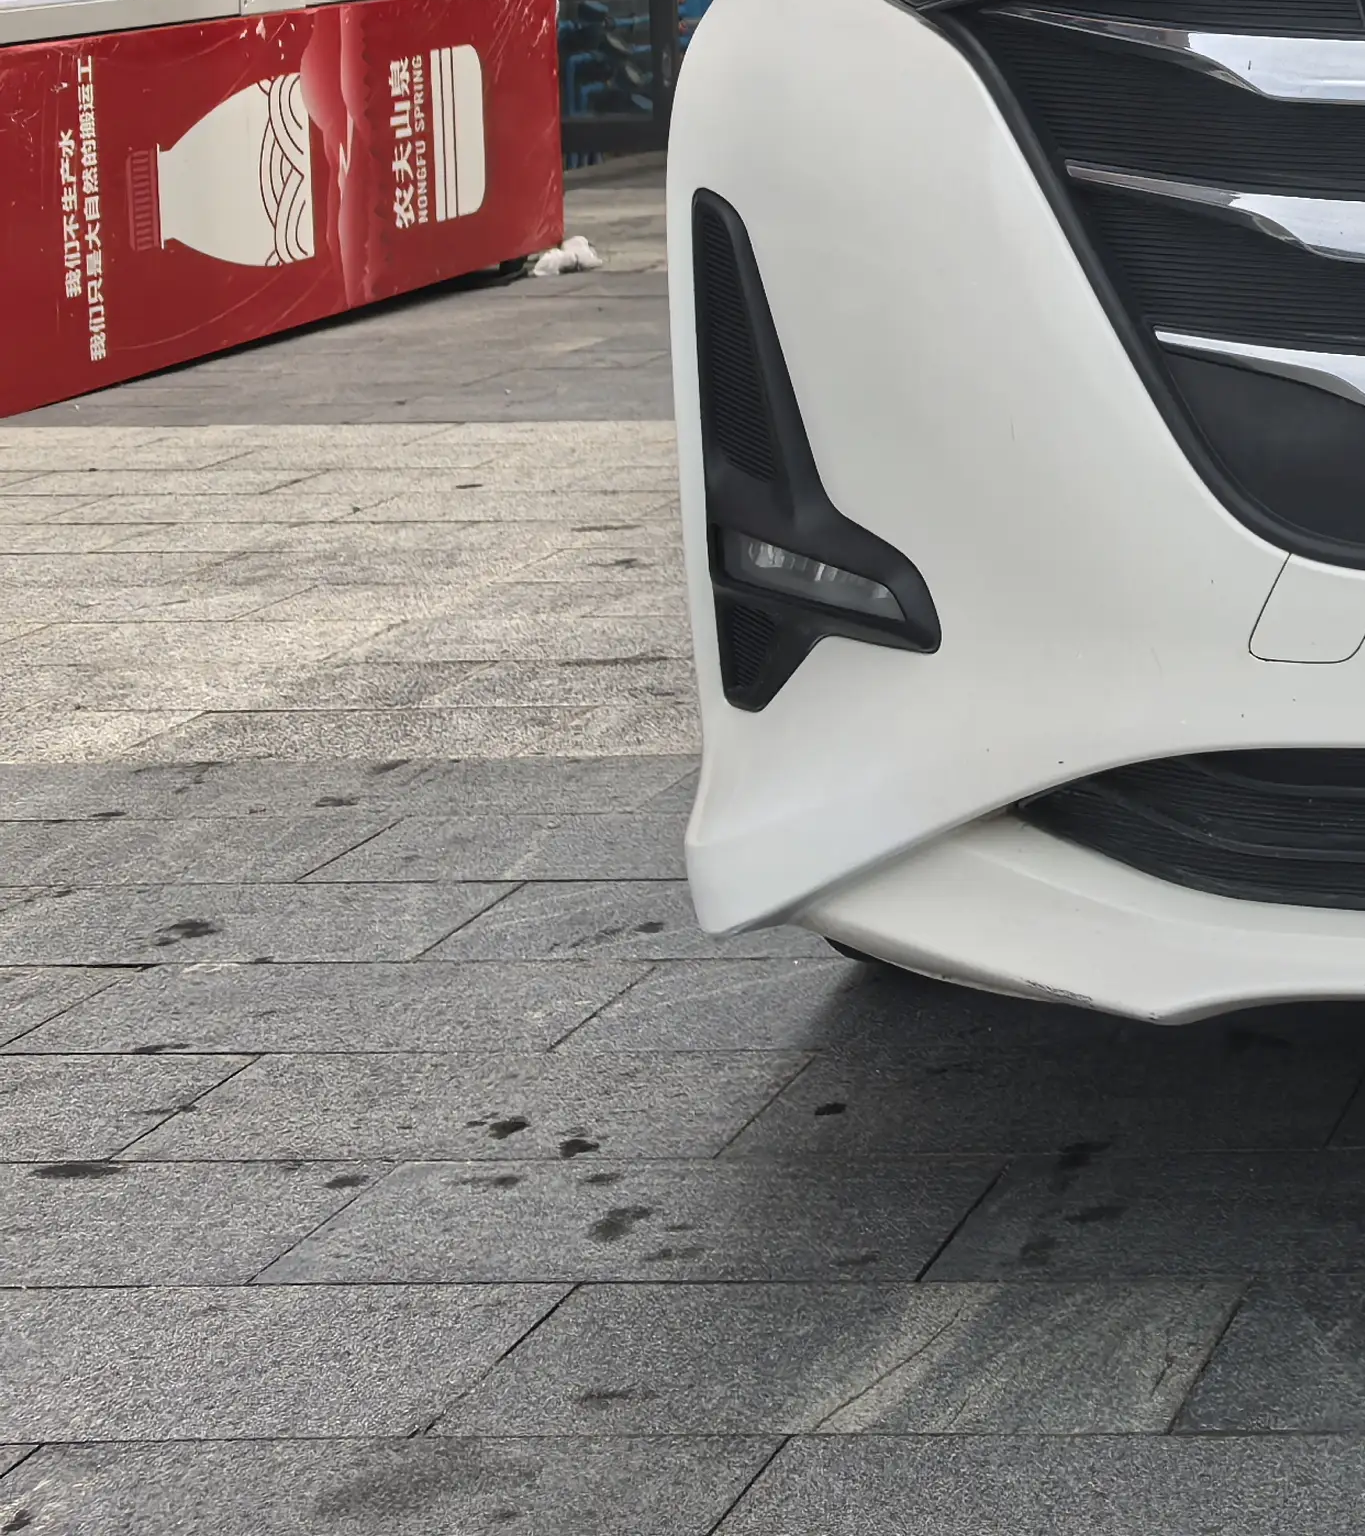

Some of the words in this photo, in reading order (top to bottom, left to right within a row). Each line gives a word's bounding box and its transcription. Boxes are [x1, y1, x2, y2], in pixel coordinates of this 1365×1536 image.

[388, 55, 416, 229] 农夫山泉
[411, 54, 425, 132] SPRING
[58, 128, 83, 298] 我们不生产水
[77, 54, 107, 362] 我们只是大自然的搬运工
[416, 140, 429, 224] NONGFU
